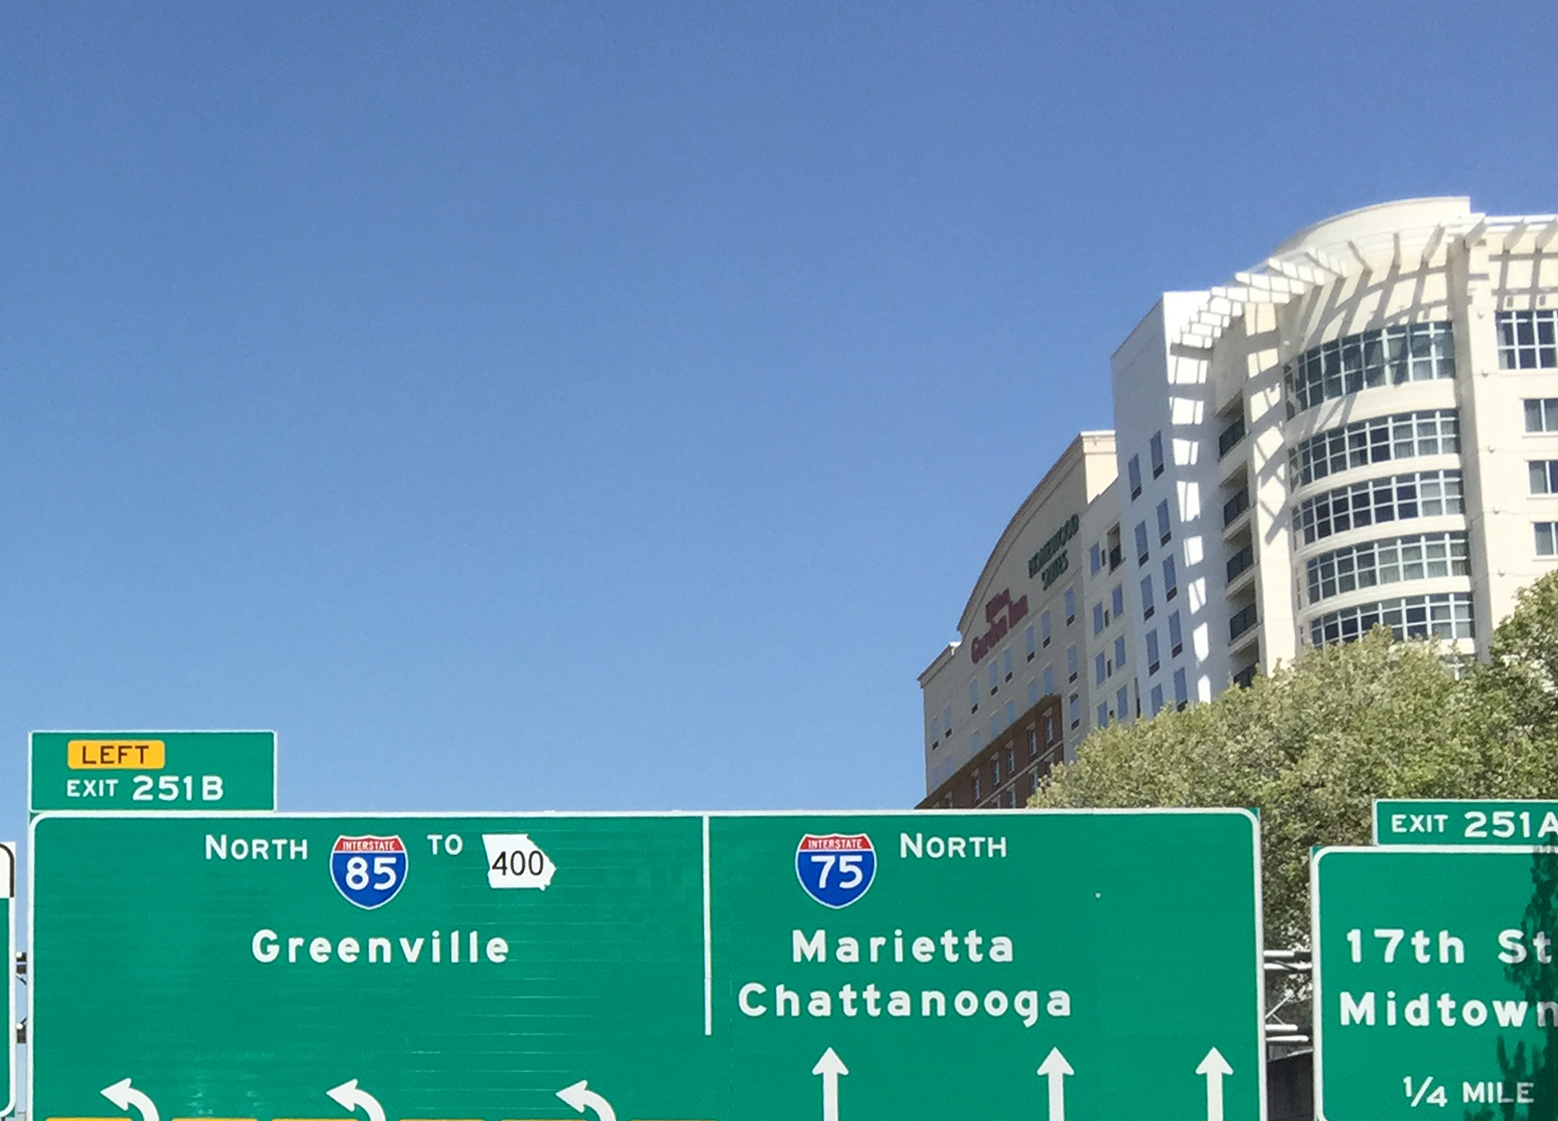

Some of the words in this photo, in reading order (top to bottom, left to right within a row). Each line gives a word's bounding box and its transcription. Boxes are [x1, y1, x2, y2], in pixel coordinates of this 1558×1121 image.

[83, 746, 149, 764] LEFT
[67, 779, 118, 797] EXIT
[133, 775, 223, 800] 251B
[1391, 814, 1449, 833] EXIT
[1464, 811, 1558, 838] 251A
[205, 834, 308, 860] NORTH
[342, 840, 395, 851] INTERSTATE
[427, 834, 463, 855] TO
[807, 838, 863, 850] INTERSTATE
[900, 832, 1007, 858] NORTH
[345, 856, 397, 891] 85
[491, 850, 545, 876] 400
[810, 854, 863, 890] 75
[252, 929, 509, 963] Greenville
[792, 929, 1013, 963] Marietta
[1347, 929, 1465, 964] 17th
[1498, 929, 1552, 964] St
[738, 982, 1071, 1028] Chattanooga
[1340, 991, 1558, 1028] Midtown
[1462, 1081, 1535, 1104] MILE
